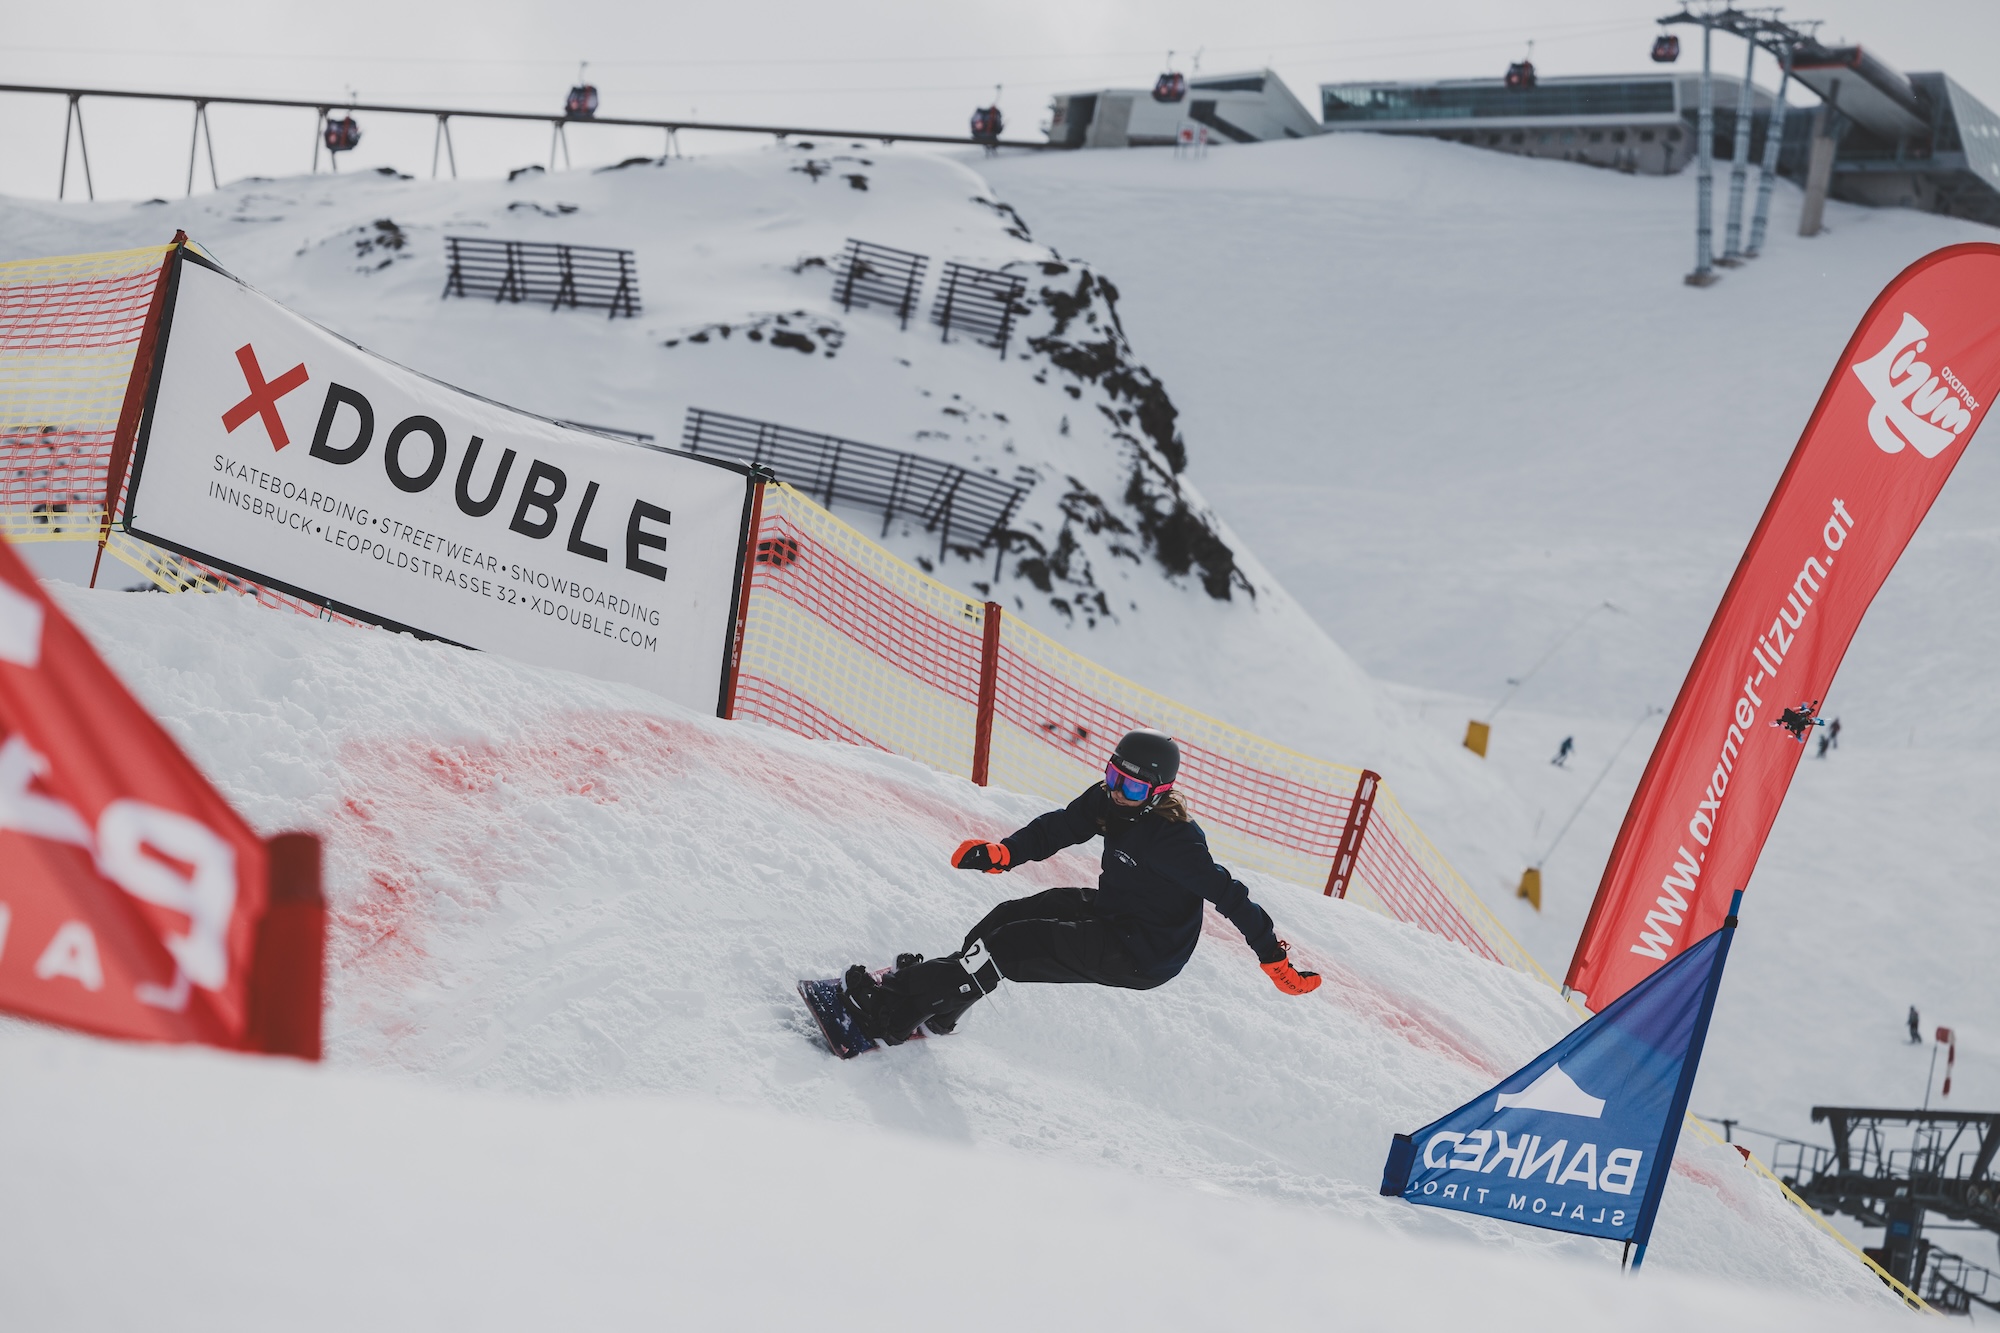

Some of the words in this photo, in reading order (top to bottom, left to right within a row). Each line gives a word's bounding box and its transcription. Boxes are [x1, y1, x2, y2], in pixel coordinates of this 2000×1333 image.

[1941, 366, 1980, 411] axamer
[497, 585, 517, 605] 32
[1630, 497, 1856, 961] www.axamer-lizum.at
